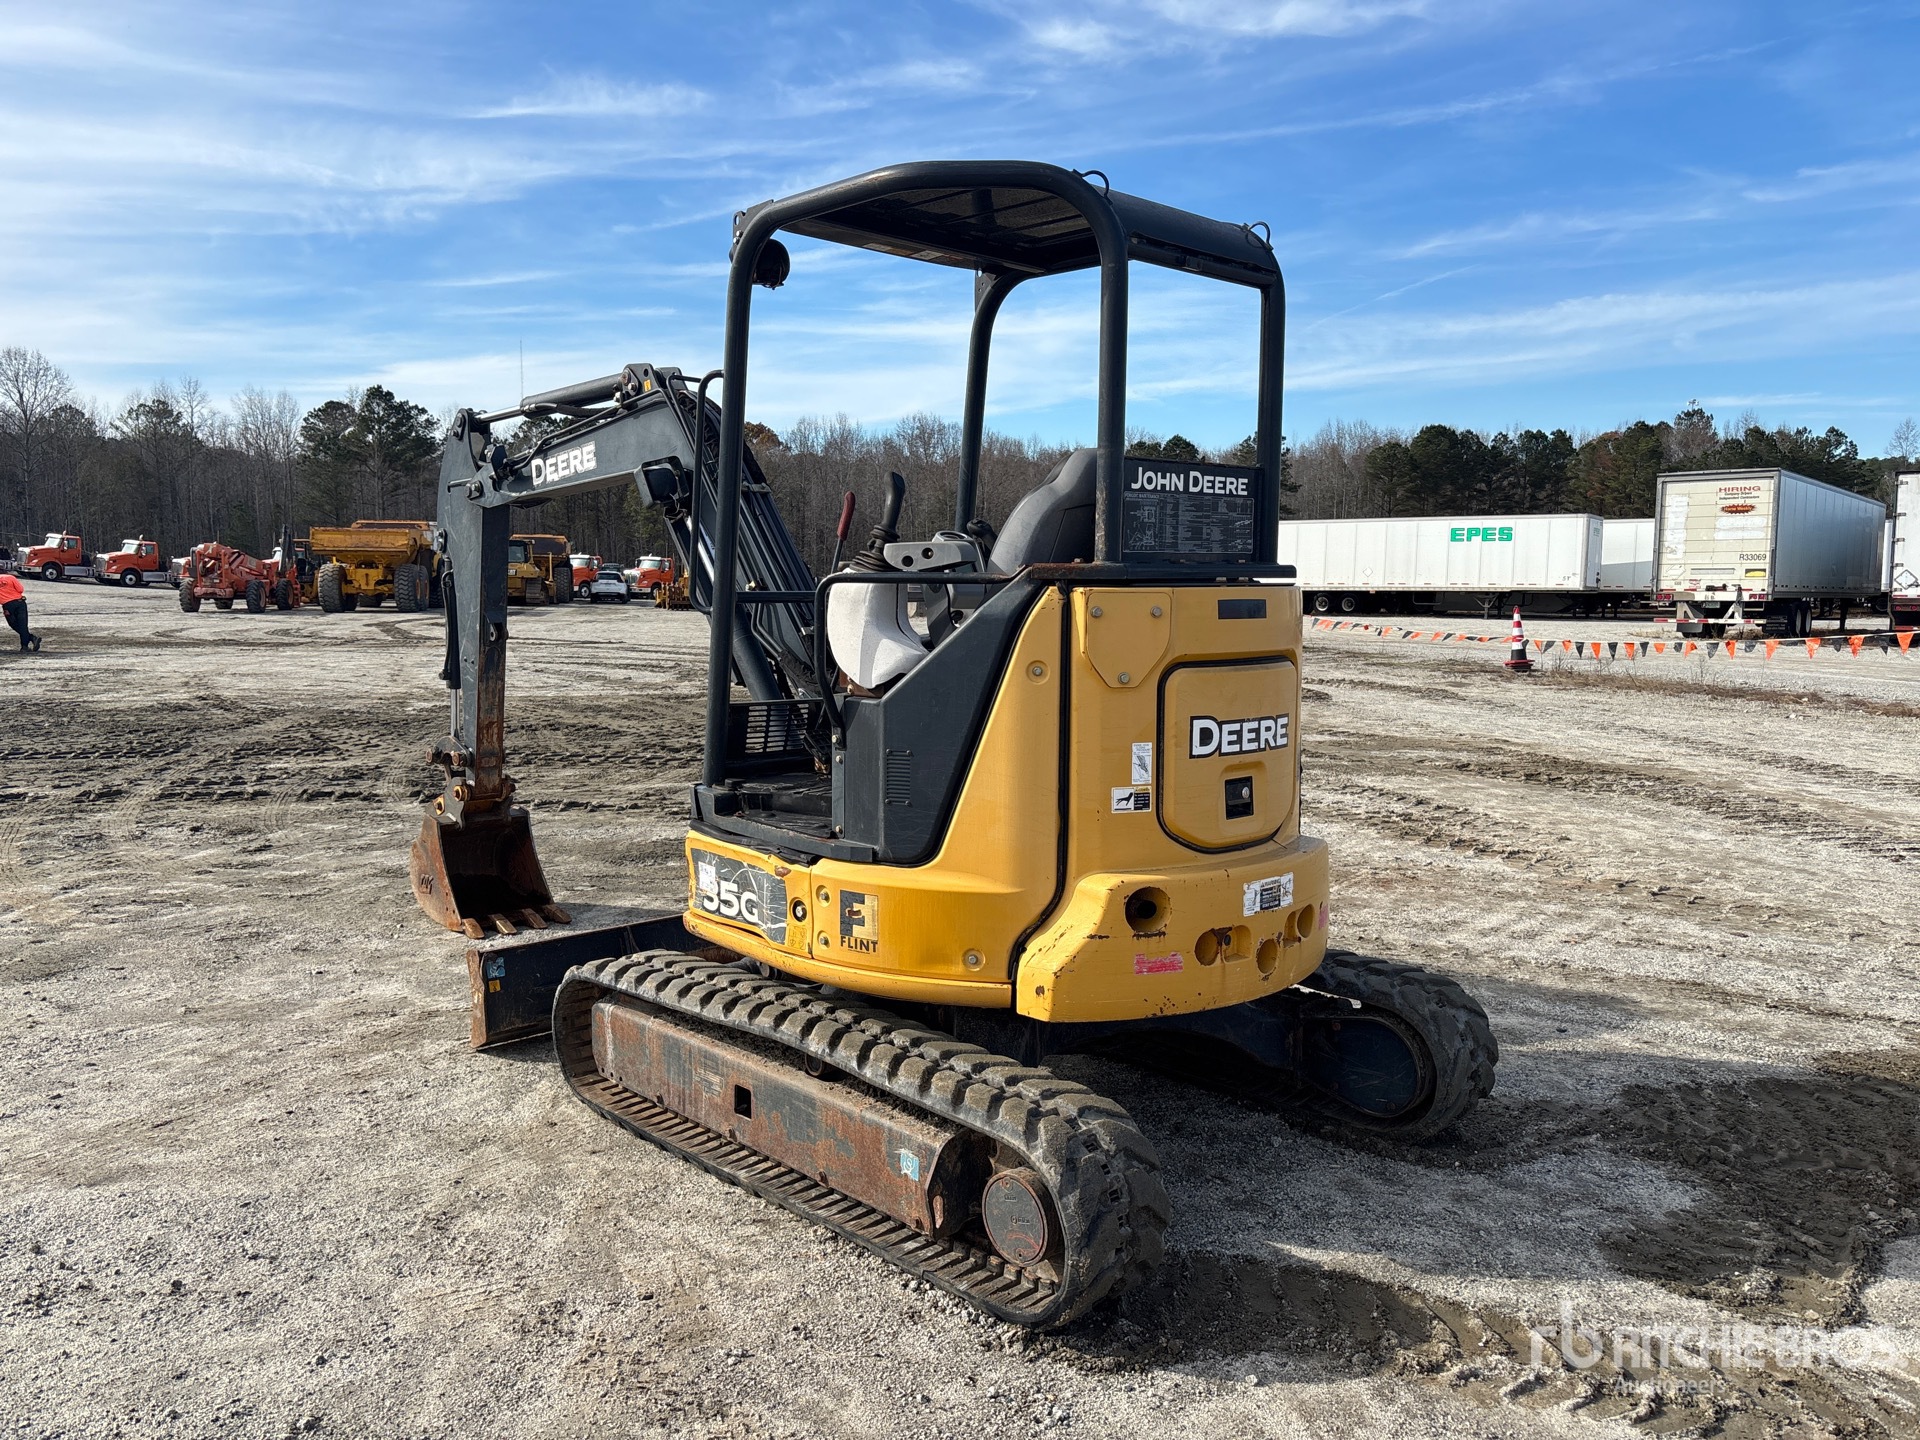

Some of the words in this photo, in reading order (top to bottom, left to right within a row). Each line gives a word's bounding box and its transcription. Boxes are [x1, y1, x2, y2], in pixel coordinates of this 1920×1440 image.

[531, 442, 597, 486] DEERE
[1131, 467, 1184, 492] JOHN
[1189, 471, 1248, 496] DEERE
[1450, 527, 1513, 542] EPES
[1739, 553, 1767, 561] R33069
[1190, 715, 1289, 757] DEERE
[840, 935, 878, 953] FLINT
